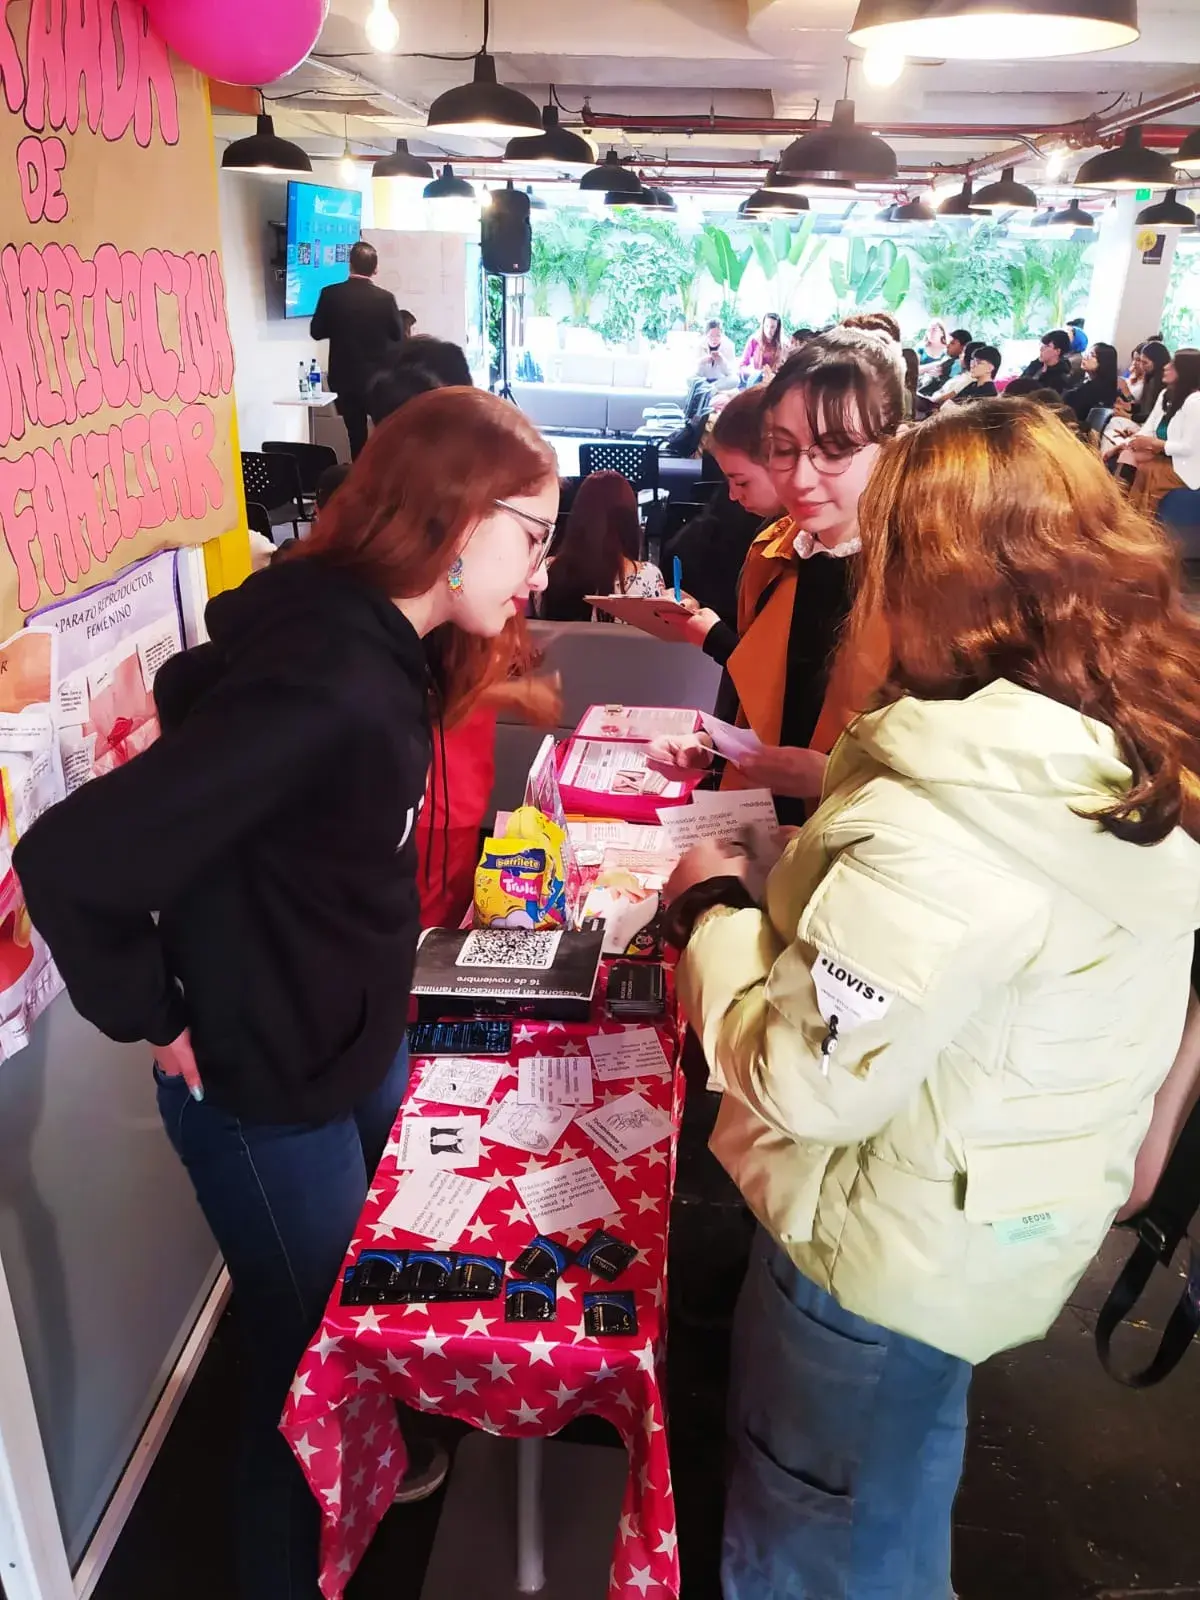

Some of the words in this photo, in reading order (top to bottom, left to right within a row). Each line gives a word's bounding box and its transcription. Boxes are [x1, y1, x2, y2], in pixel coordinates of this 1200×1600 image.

[16, 135, 69, 224] DE
[0, 402, 225, 612] FAMILIAR
[55, 604, 97, 634] PARATO
[97, 570, 154, 616] REPRODUCTOR
[86, 602, 132, 640] FEMENINO
[495, 855, 541, 869] barrilete
[456, 976, 512, 985] noviembre
[514, 977, 527, 986] de
